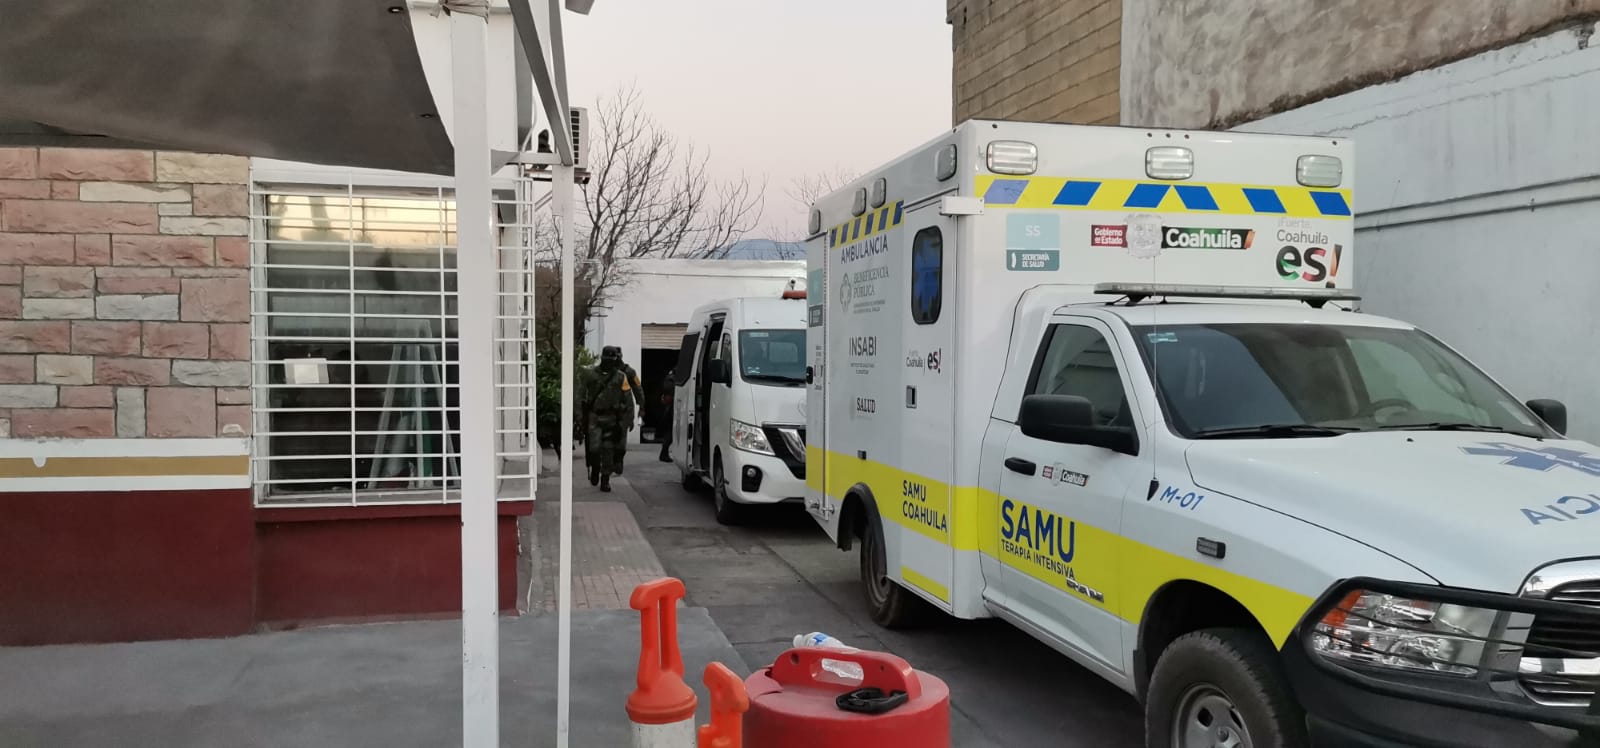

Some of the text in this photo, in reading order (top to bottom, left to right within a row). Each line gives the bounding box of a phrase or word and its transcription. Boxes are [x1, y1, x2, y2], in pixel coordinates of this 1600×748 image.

[1025, 225, 1041, 237] SS
[1094, 227, 1123, 237] Gobierno
[1101, 236, 1123, 244] Estado
[1166, 228, 1242, 249] Coahuila
[1276, 229, 1328, 244] Coahuila
[841, 234, 888, 264] AMBULANCIA
[1276, 243, 1343, 288] es!
[849, 336, 877, 357] INSABI
[927, 347, 942, 374] es!
[856, 397, 876, 414] SALUD
[1062, 471, 1086, 486] Coahuila
[902, 479, 927, 503] SAMU
[1160, 486, 1205, 511] M-01
[902, 500, 948, 533] COAHUILA
[1001, 499, 1075, 563] SAMU
[1001, 539, 1075, 581] TERAPIA INTENSIVA
